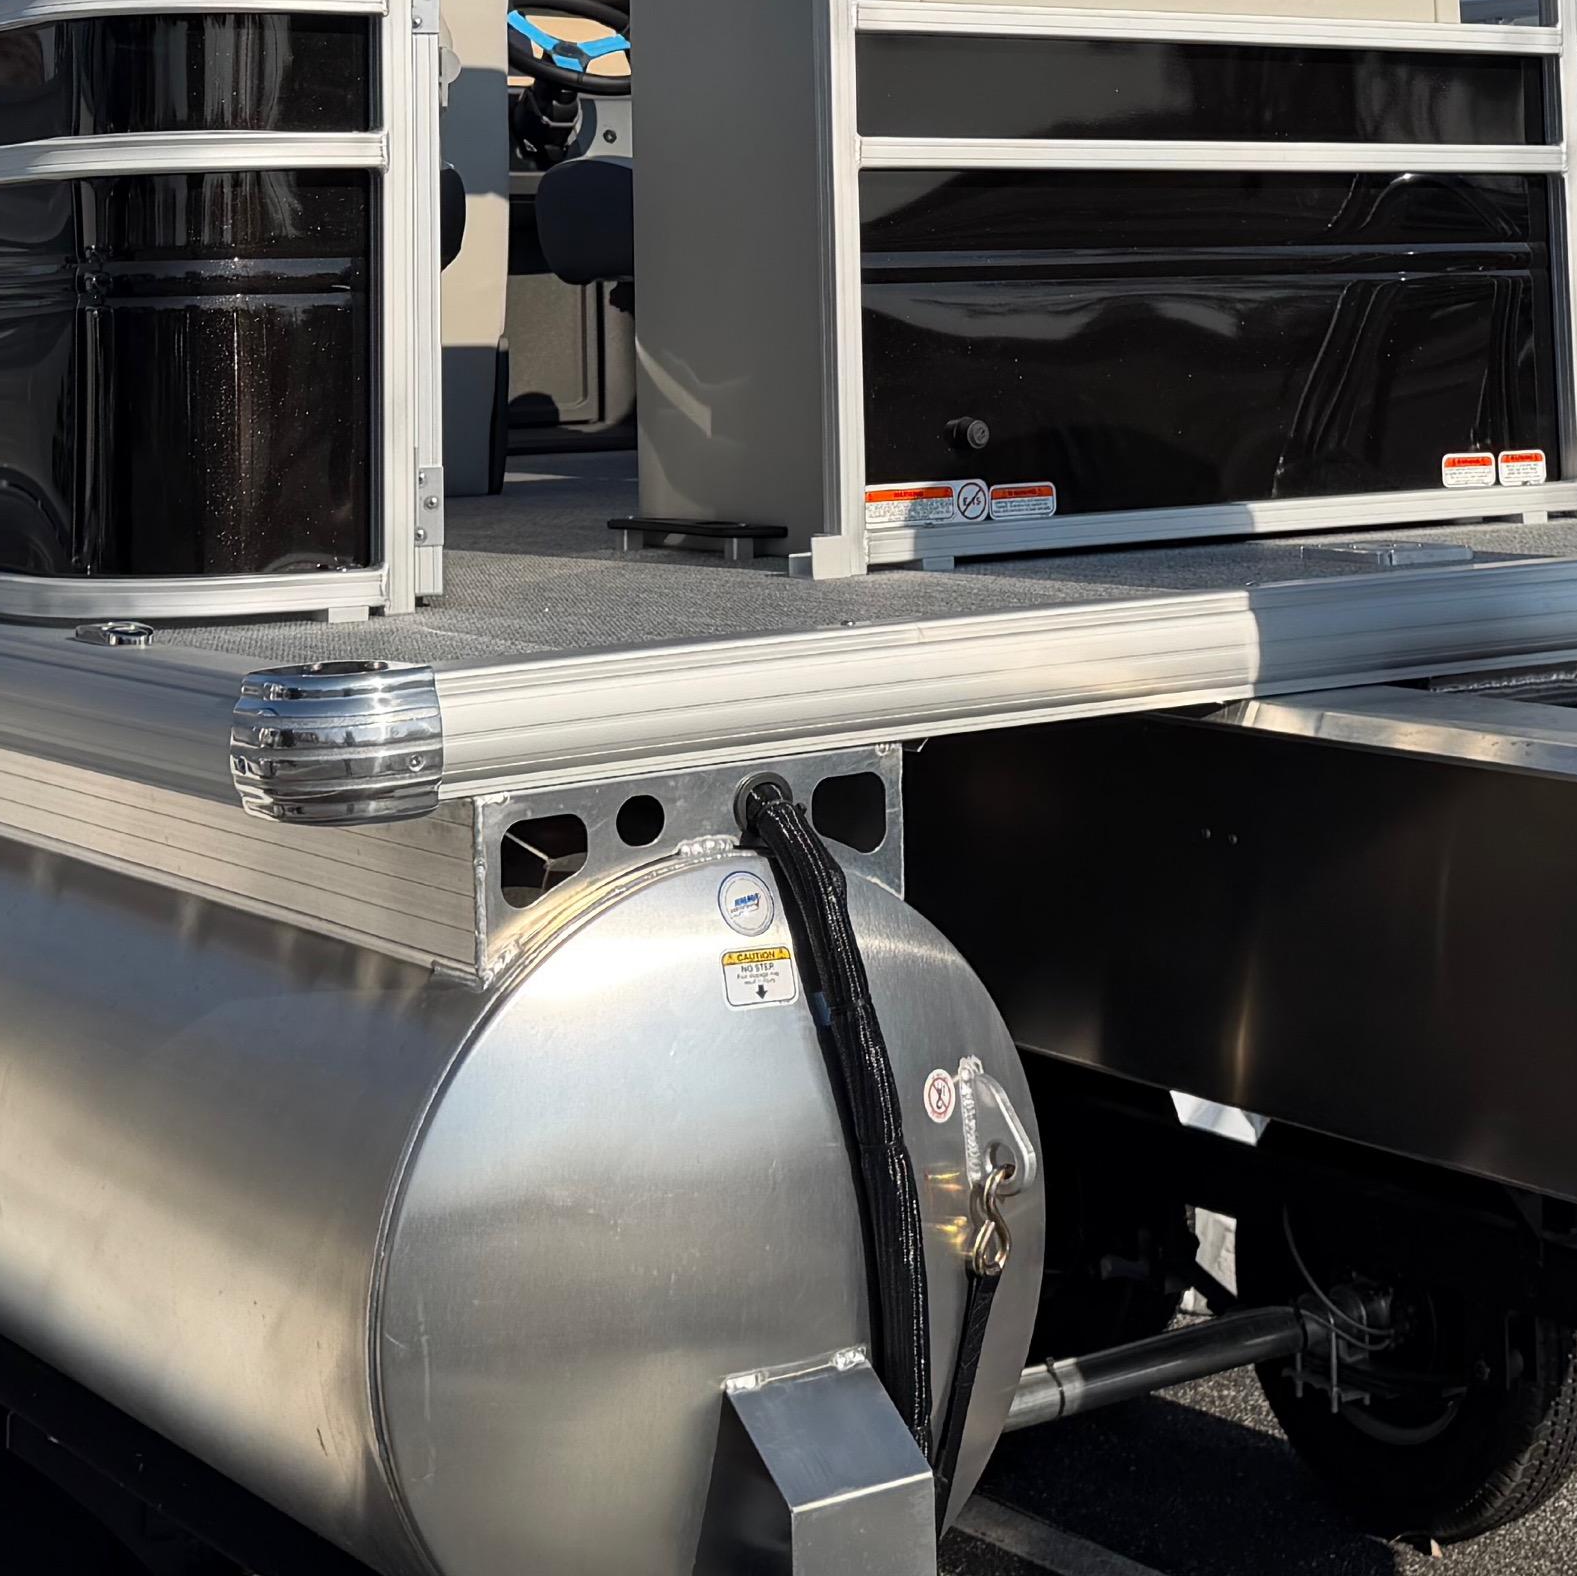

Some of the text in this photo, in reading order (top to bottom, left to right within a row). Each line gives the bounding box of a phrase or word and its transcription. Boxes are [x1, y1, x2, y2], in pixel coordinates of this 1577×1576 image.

[736, 950, 776, 962] CAUTION
[740, 962, 775, 973] NO STEP
